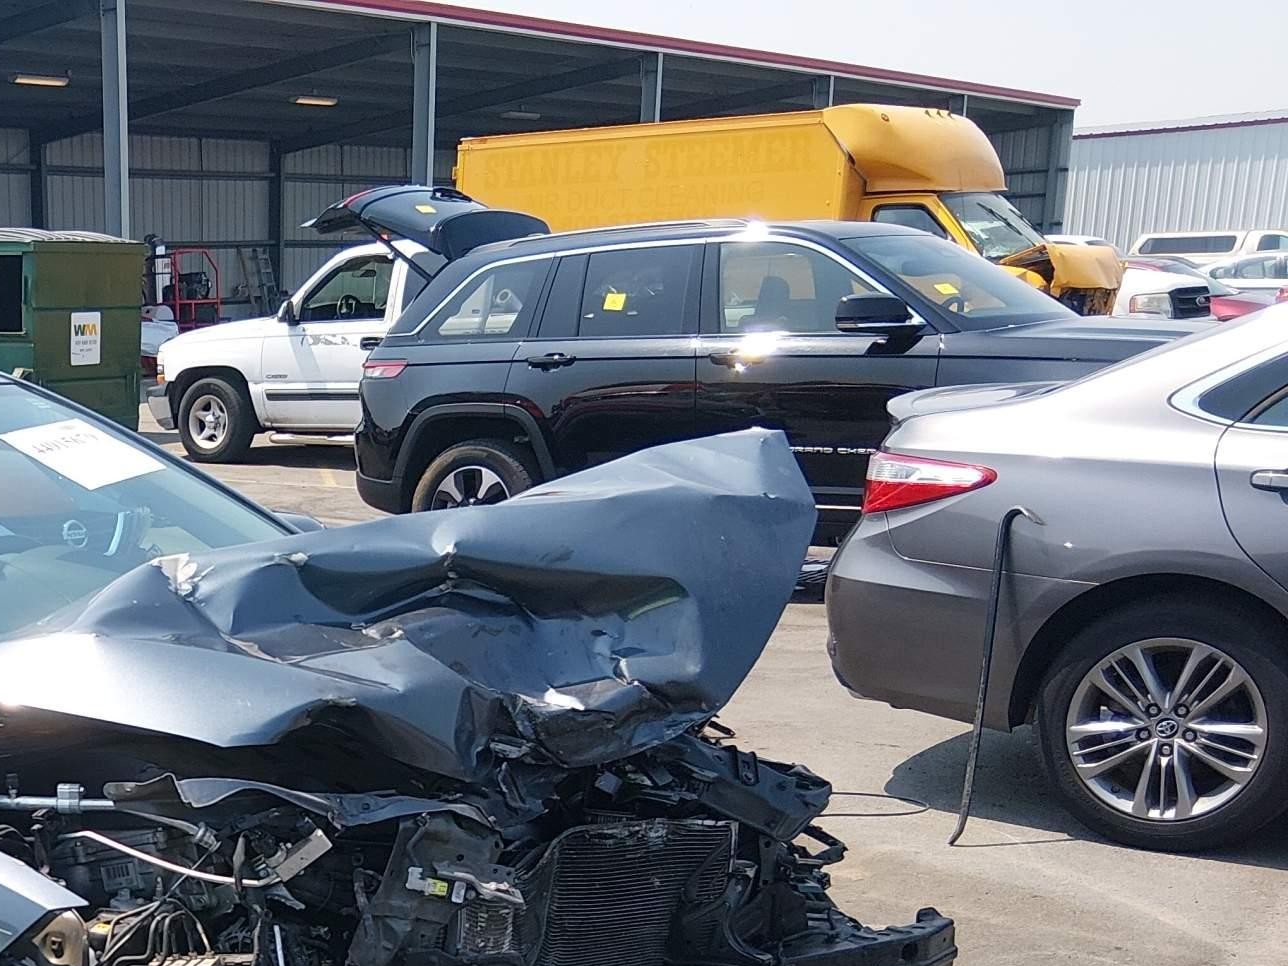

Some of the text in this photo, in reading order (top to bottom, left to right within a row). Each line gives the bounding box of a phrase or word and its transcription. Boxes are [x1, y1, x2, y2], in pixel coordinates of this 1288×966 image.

[484, 133, 814, 191] STANLEY STEEMER
[568, 187, 633, 211] DUCT
[73, 323, 97, 337] WM
